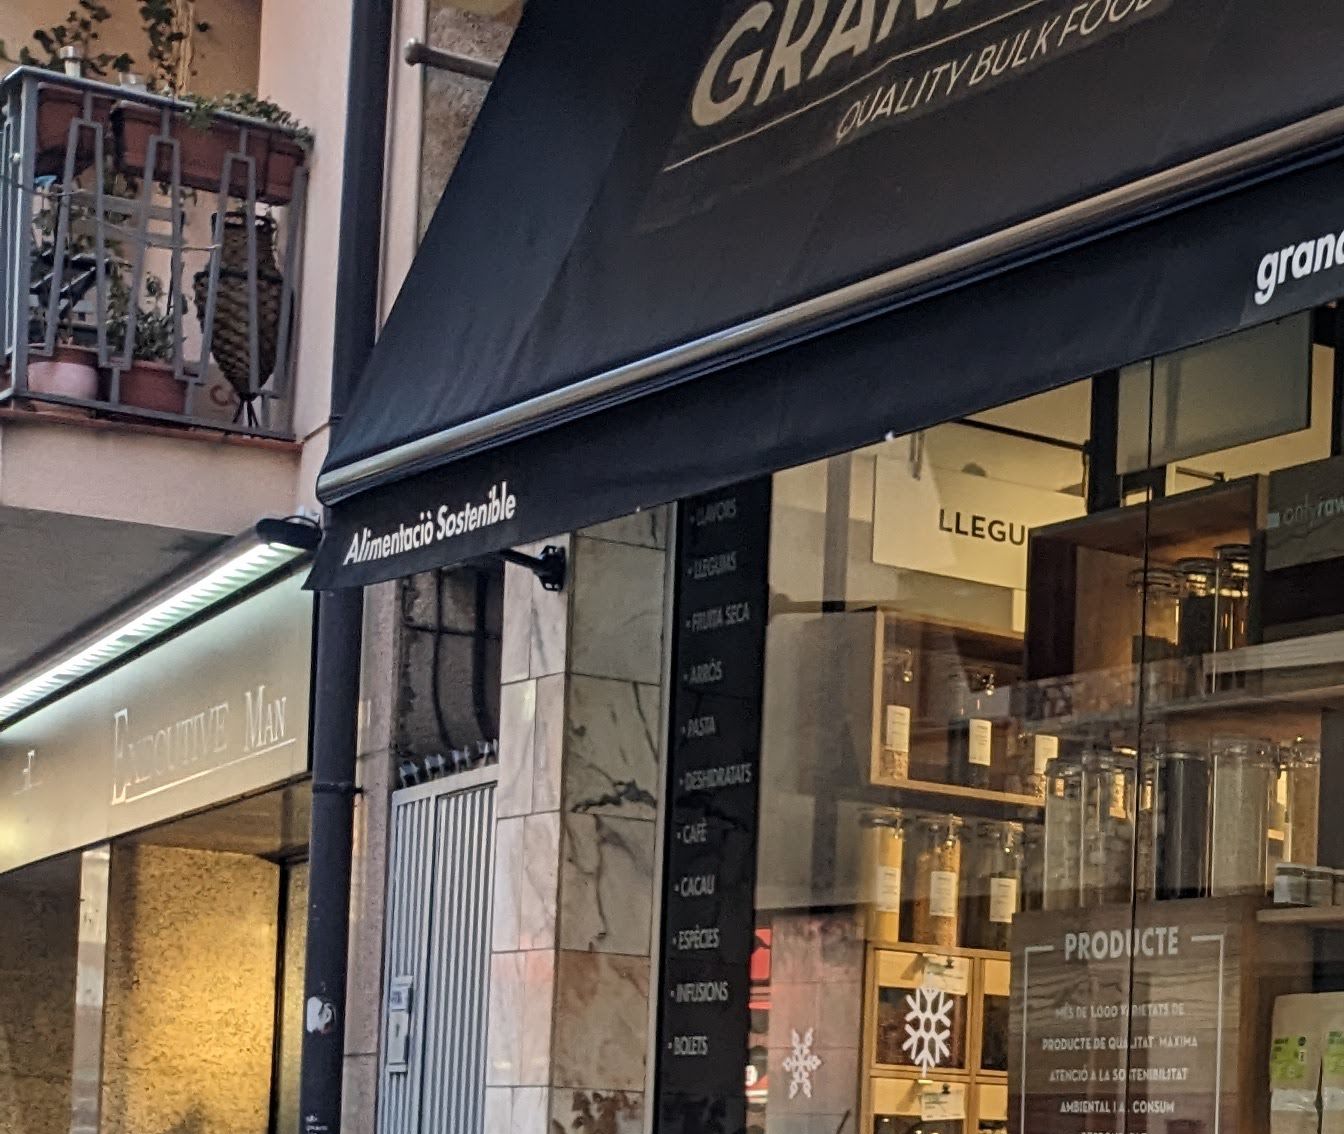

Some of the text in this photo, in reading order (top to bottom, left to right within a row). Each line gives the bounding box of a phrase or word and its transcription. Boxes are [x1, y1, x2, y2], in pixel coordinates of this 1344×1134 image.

[835, 54, 975, 146] QUALITY
[968, 15, 1061, 89] BULK
[436, 480, 517, 541] Sostenible
[939, 508, 1026, 546] LLEGU
[725, 600, 751, 626] SECA
[687, 715, 716, 738] PASTA
[112, 702, 229, 806] EXECUTIVE
[685, 763, 752, 791] DESHIDRATATS
[680, 874, 716, 897] CACAU
[1064, 926, 1180, 961] PRODUCTE
[676, 981, 729, 1003] INFUSIONS
[1076, 1006, 1087, 1018] DE
[1171, 1003, 1185, 1017] DE
[673, 1035, 708, 1056] BOLETS
[1042, 1037, 1092, 1050] PRODUCTE
[1093, 1037, 1106, 1049] DE
[1090, 1069, 1097, 1081] A
[1099, 1069, 1110, 1081] LA
[1060, 1101, 1111, 1113] AMBIENTAL
[1132, 1100, 1176, 1113] CONSUM
